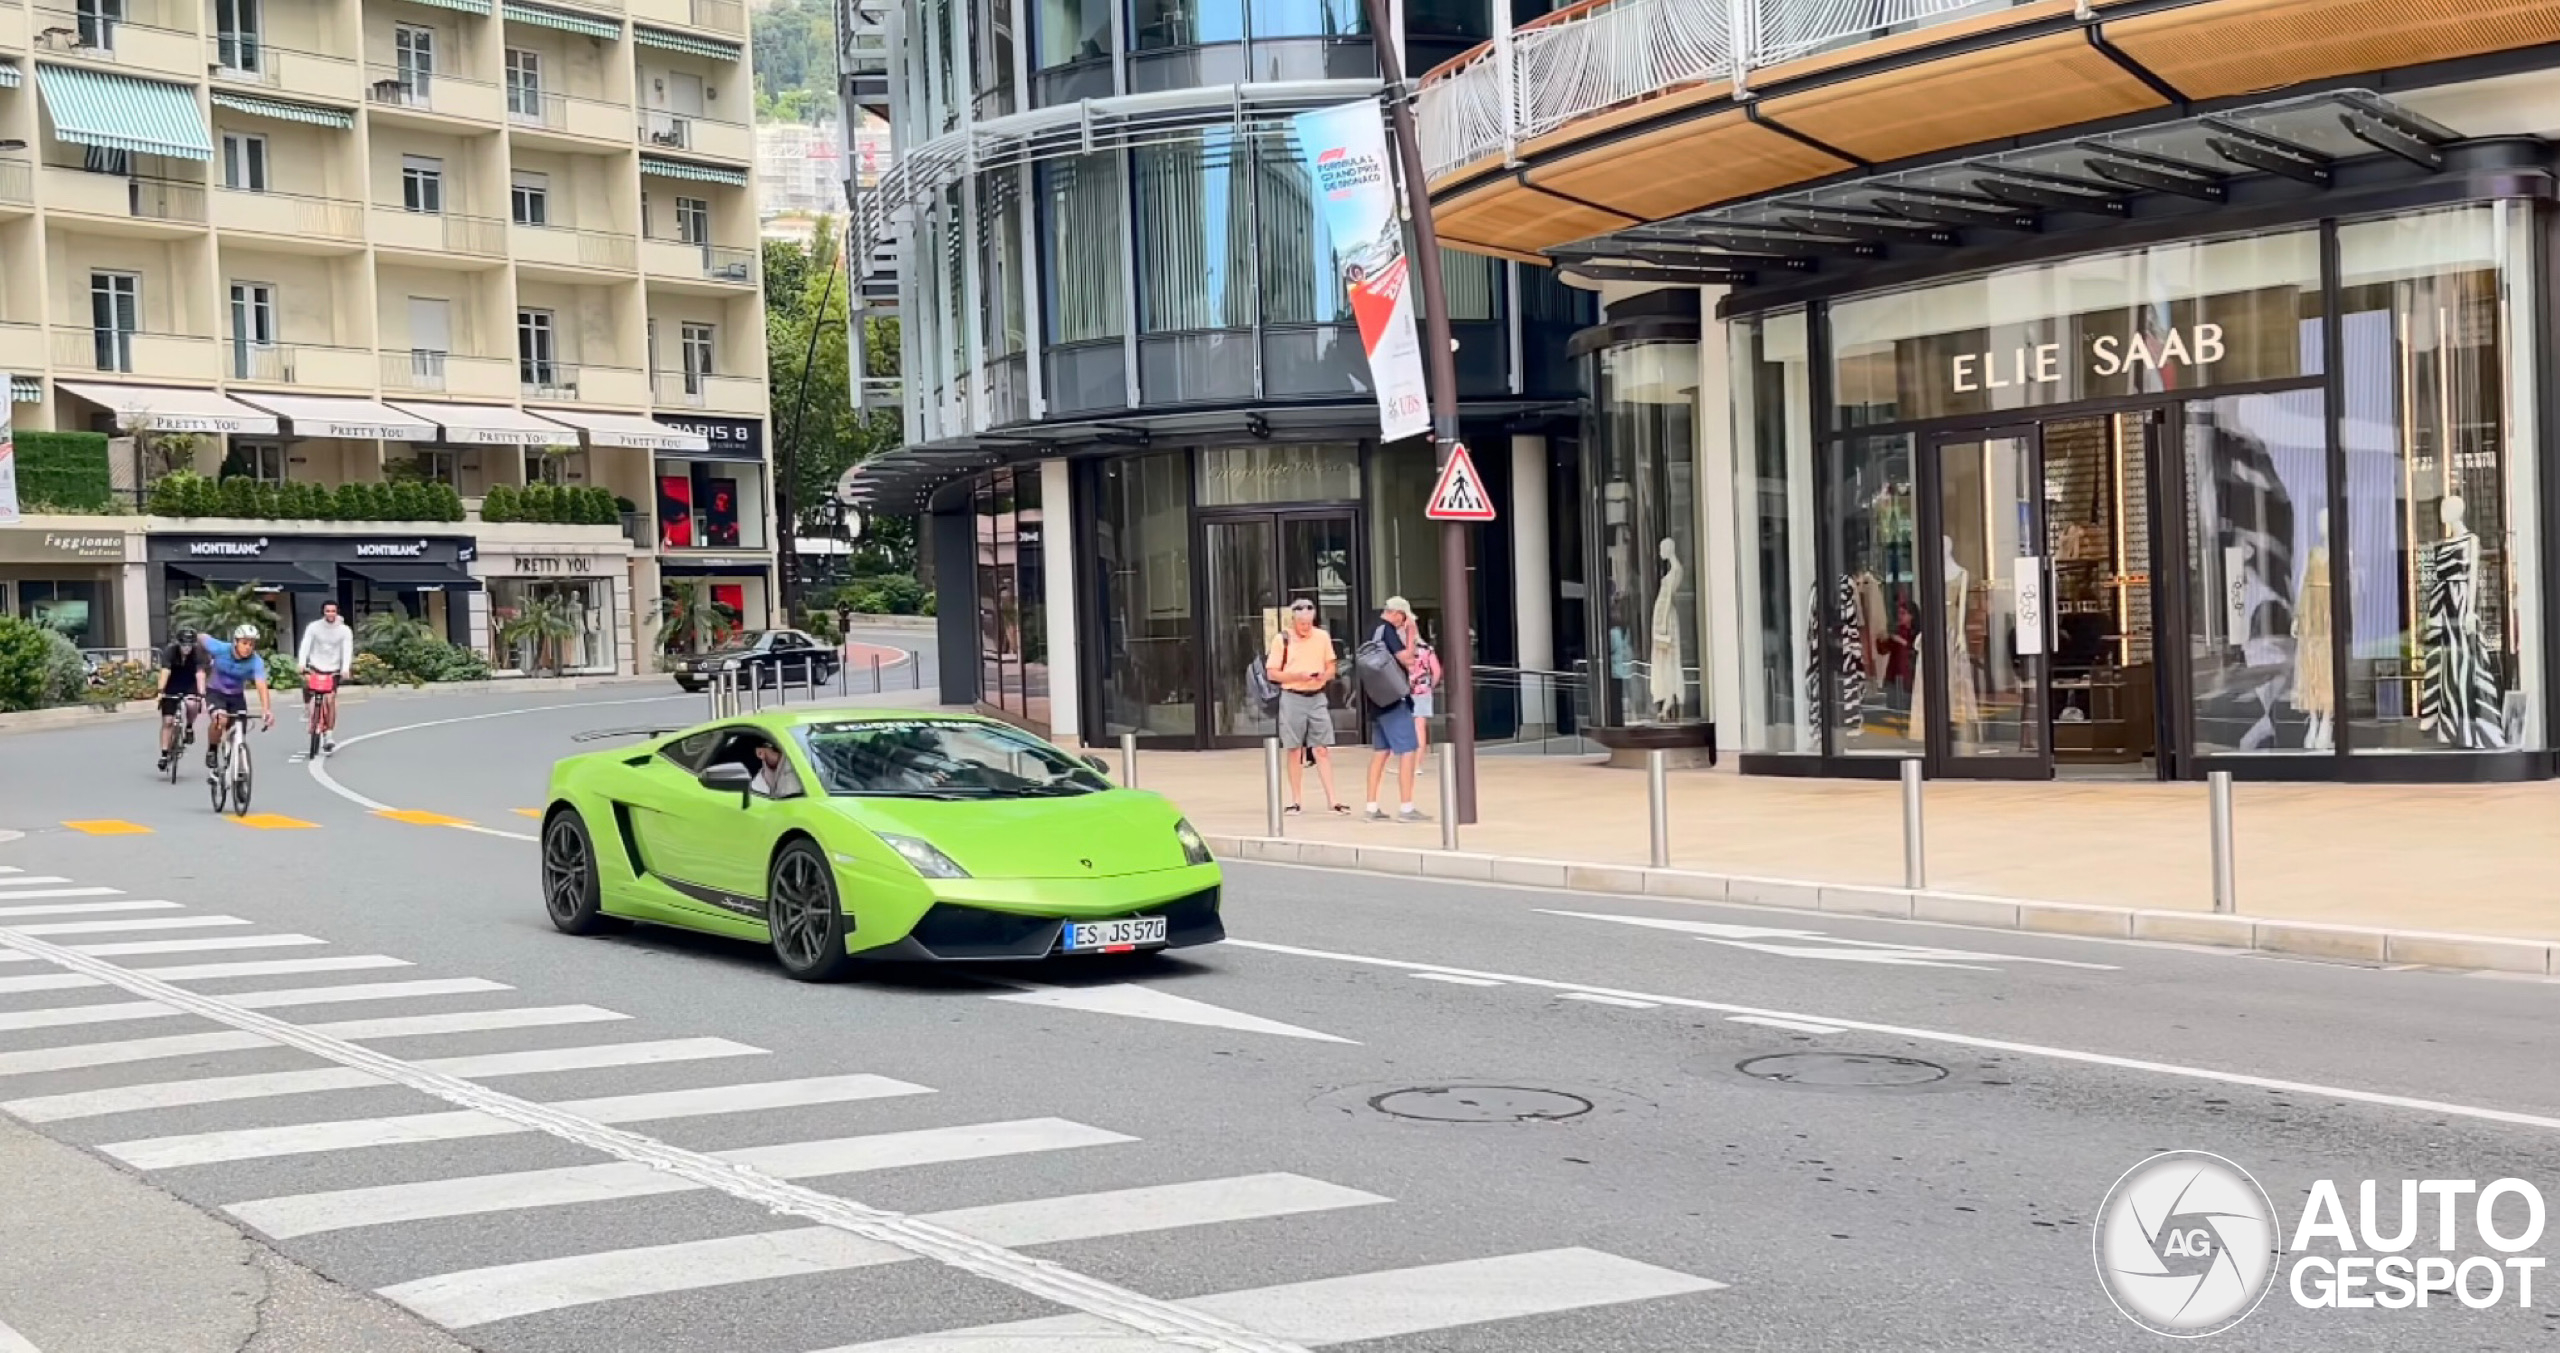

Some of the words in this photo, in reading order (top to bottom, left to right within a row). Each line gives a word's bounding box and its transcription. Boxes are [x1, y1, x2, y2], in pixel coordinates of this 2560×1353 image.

[1953, 343, 2062, 393] ELIE
[2092, 323, 2225, 376] SAAB
[157, 417, 207, 430] PRETTY
[214, 419, 240, 431] YOU
[330, 424, 375, 437] PRETTY
[381, 427, 404, 438] YOU
[479, 431, 520, 443] PRETTY
[735, 427, 748, 441] 8
[190, 542, 260, 556] MONTBLANC
[357, 544, 420, 557] MONTBLANC
[515, 558, 560, 572] PRETTY
[566, 558, 591, 572] YOU
[1075, 925, 1098, 946] ES
[1109, 923, 1130, 942] JS
[1134, 920, 1165, 941] 570
